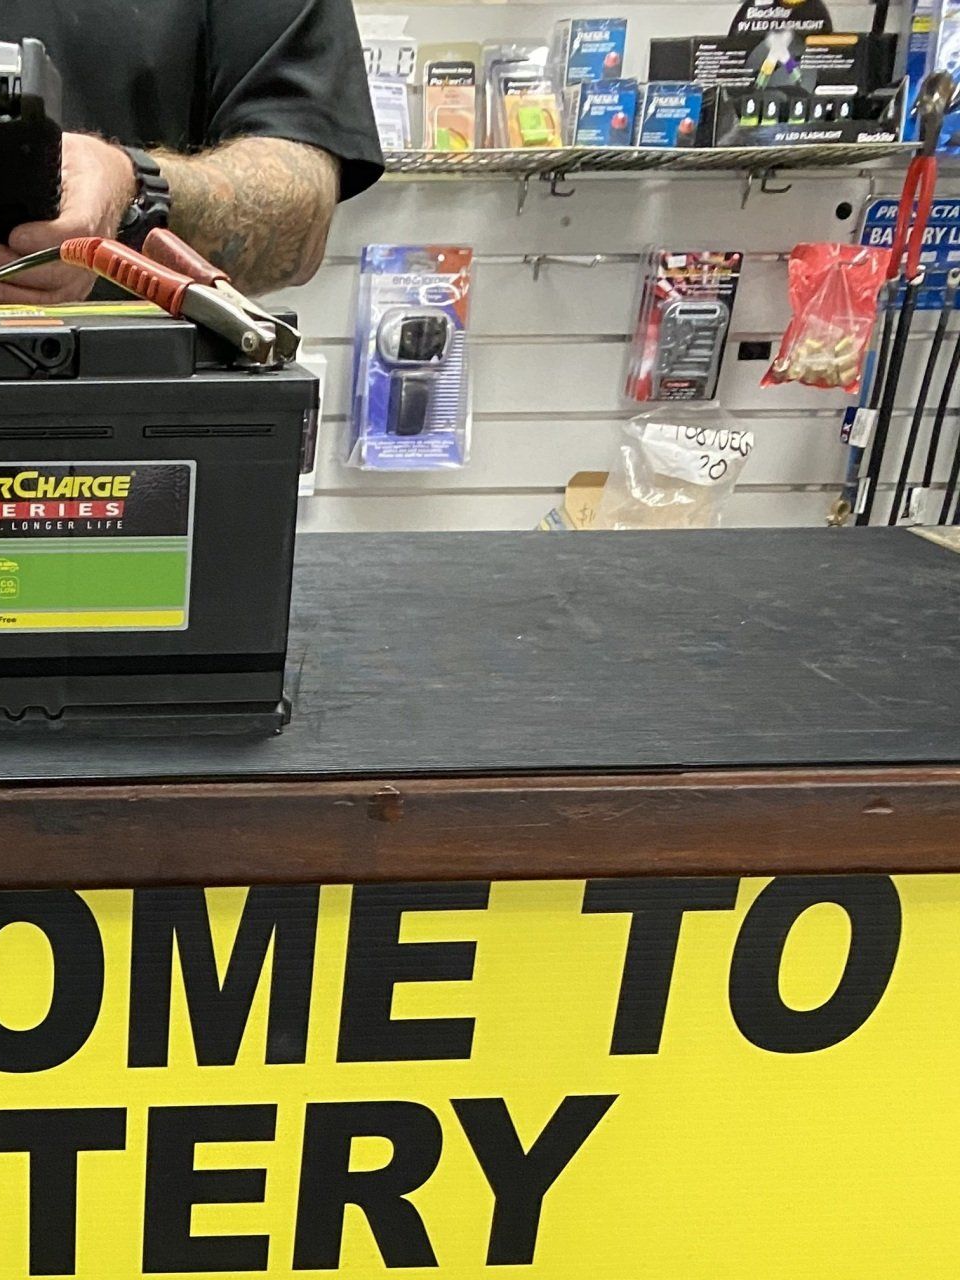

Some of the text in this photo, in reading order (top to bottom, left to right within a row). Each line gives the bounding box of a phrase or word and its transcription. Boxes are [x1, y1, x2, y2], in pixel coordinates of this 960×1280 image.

[751, 21, 769, 30] LED
[770, 19, 824, 30] FLASHLIGHT
[799, 130, 842, 140] FLASHLIGHT
[875, 205, 960, 218] PRCTA
[11, 521, 75, 530] LONGER
[87, 520, 124, 529] LIFE
[581, 875, 903, 1056] TO
